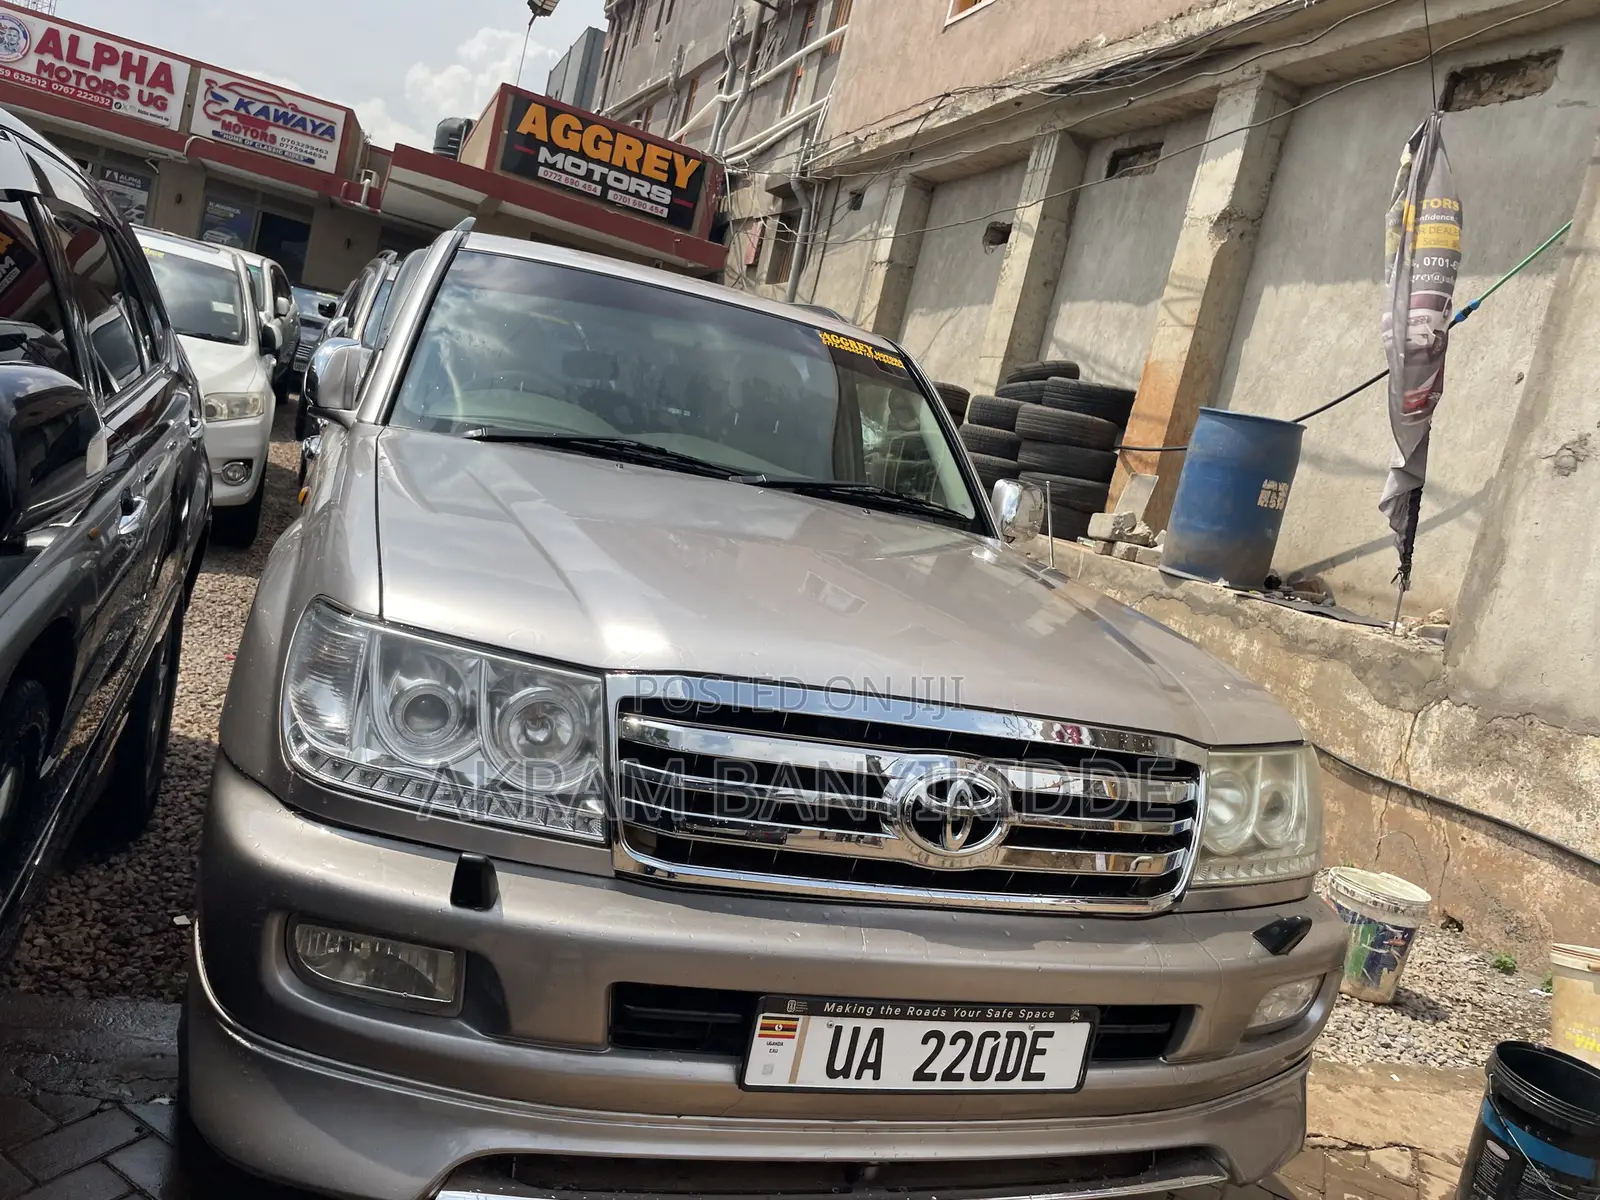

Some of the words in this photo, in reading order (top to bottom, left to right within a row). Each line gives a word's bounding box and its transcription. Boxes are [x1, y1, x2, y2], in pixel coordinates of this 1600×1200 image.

[34, 27, 175, 95] ALPHA
[13, 72, 47, 88] 632512
[51, 83, 75, 95] 0767
[76, 90, 111, 106] 222932
[36, 59, 130, 101] MOTORS
[137, 89, 169, 112] UG
[221, 120, 277, 145] MOTORS
[234, 98, 336, 141] KAWAYA
[516, 103, 702, 189] AGGREY
[538, 146, 672, 205] MOTORS
[543, 169, 563, 182] 0772
[564, 176, 580, 188] 690
[581, 183, 598, 194] 454
[612, 193, 631, 205] 0701
[632, 200, 648, 210] 690
[649, 205, 665, 216] 454
[1422, 197, 1460, 212] TORS
[822, 331, 874, 355] AGGREY
[823, 1002, 875, 1016] Making
[880, 1005, 901, 1015] the
[907, 1006, 947, 1017] Roads
[953, 1008, 981, 1018] Your
[986, 1008, 1014, 1018] Safe
[1019, 1008, 1055, 1020] Space
[825, 1025, 885, 1082] UA
[912, 1030, 1055, 1083] 220DE
